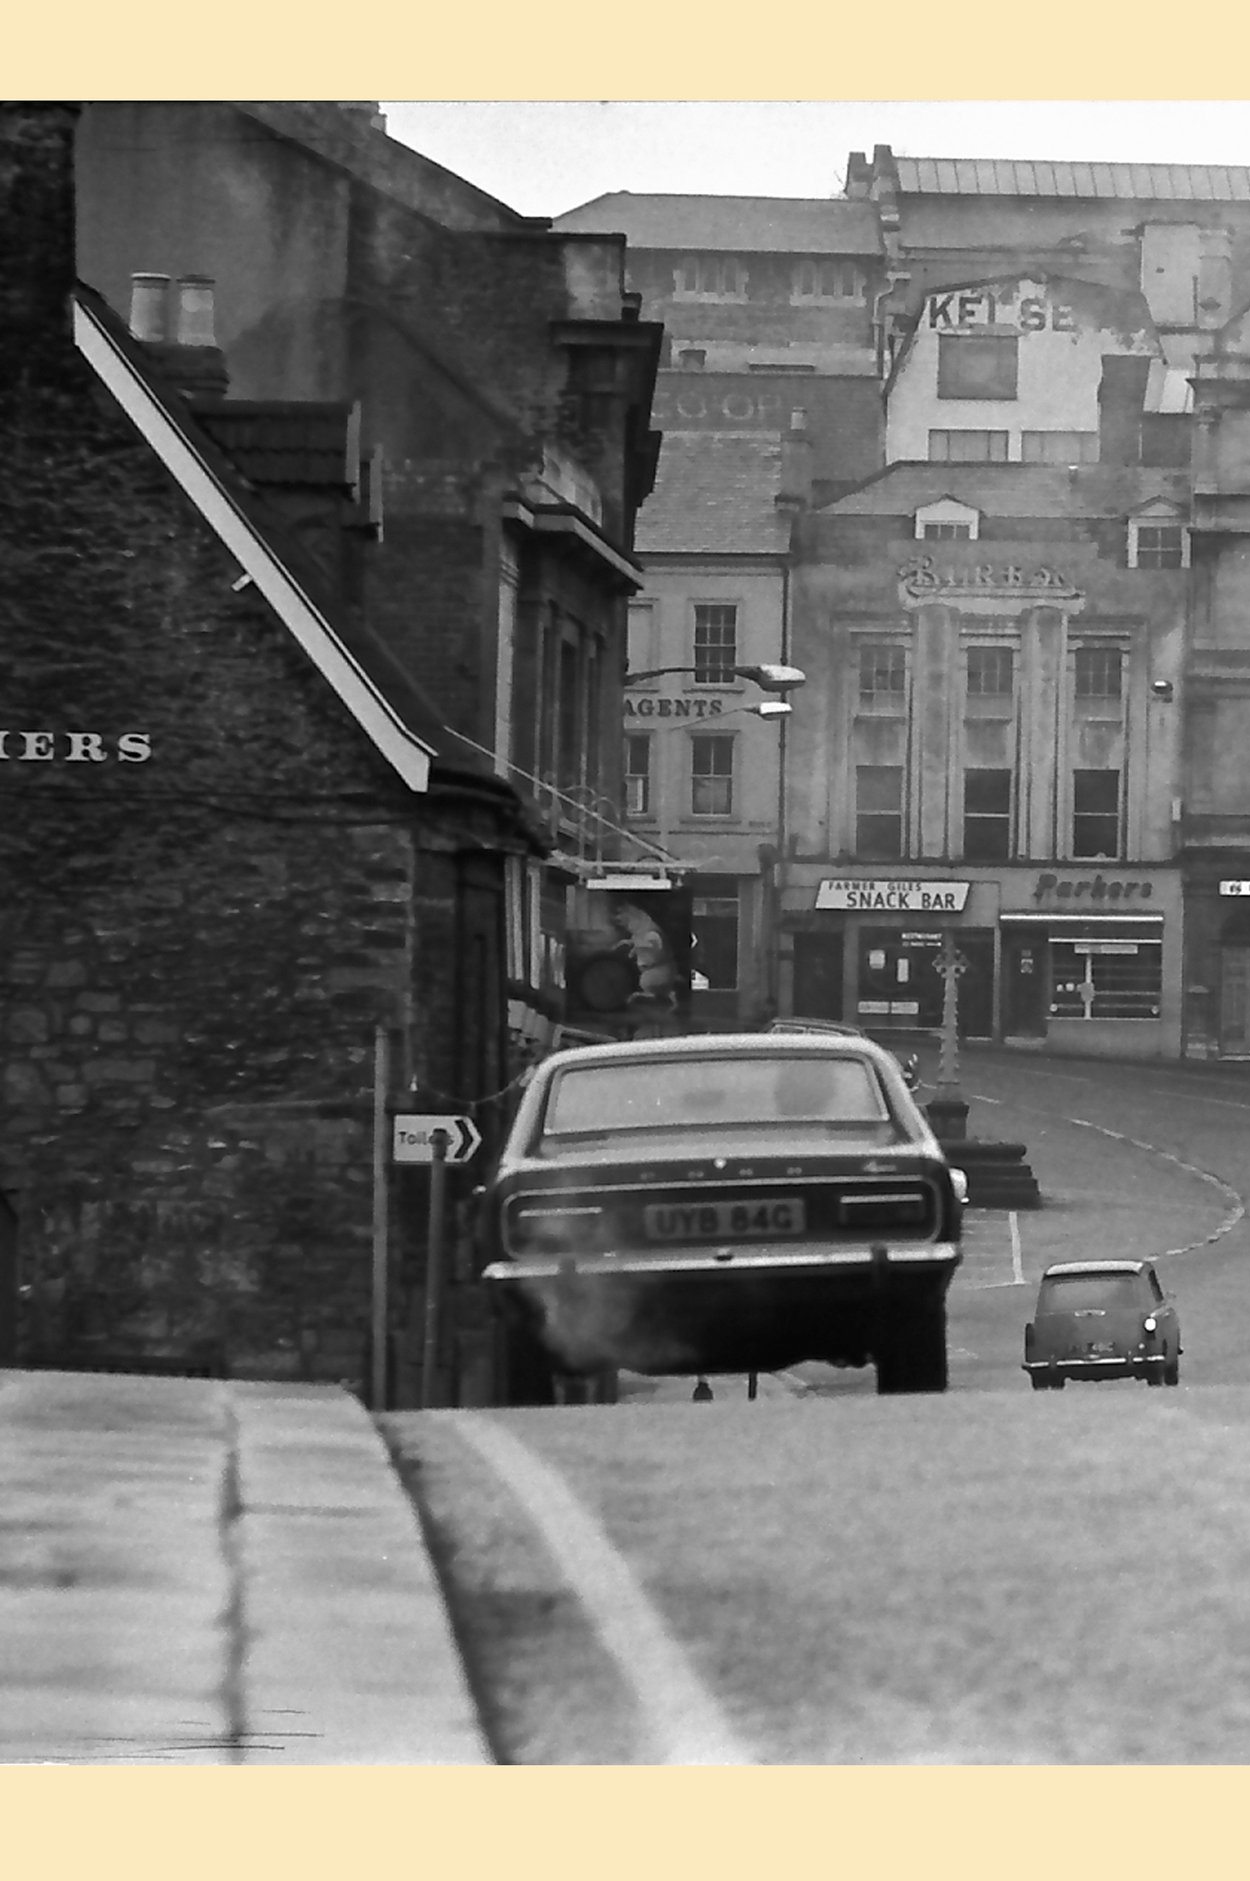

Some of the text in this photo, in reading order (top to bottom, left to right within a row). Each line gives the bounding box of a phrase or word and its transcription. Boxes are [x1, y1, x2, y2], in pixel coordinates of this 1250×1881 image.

[624, 698, 722, 717] AGENTS
[887, 882, 922, 892] GILES
[846, 891, 956, 910] SNACK BAR
